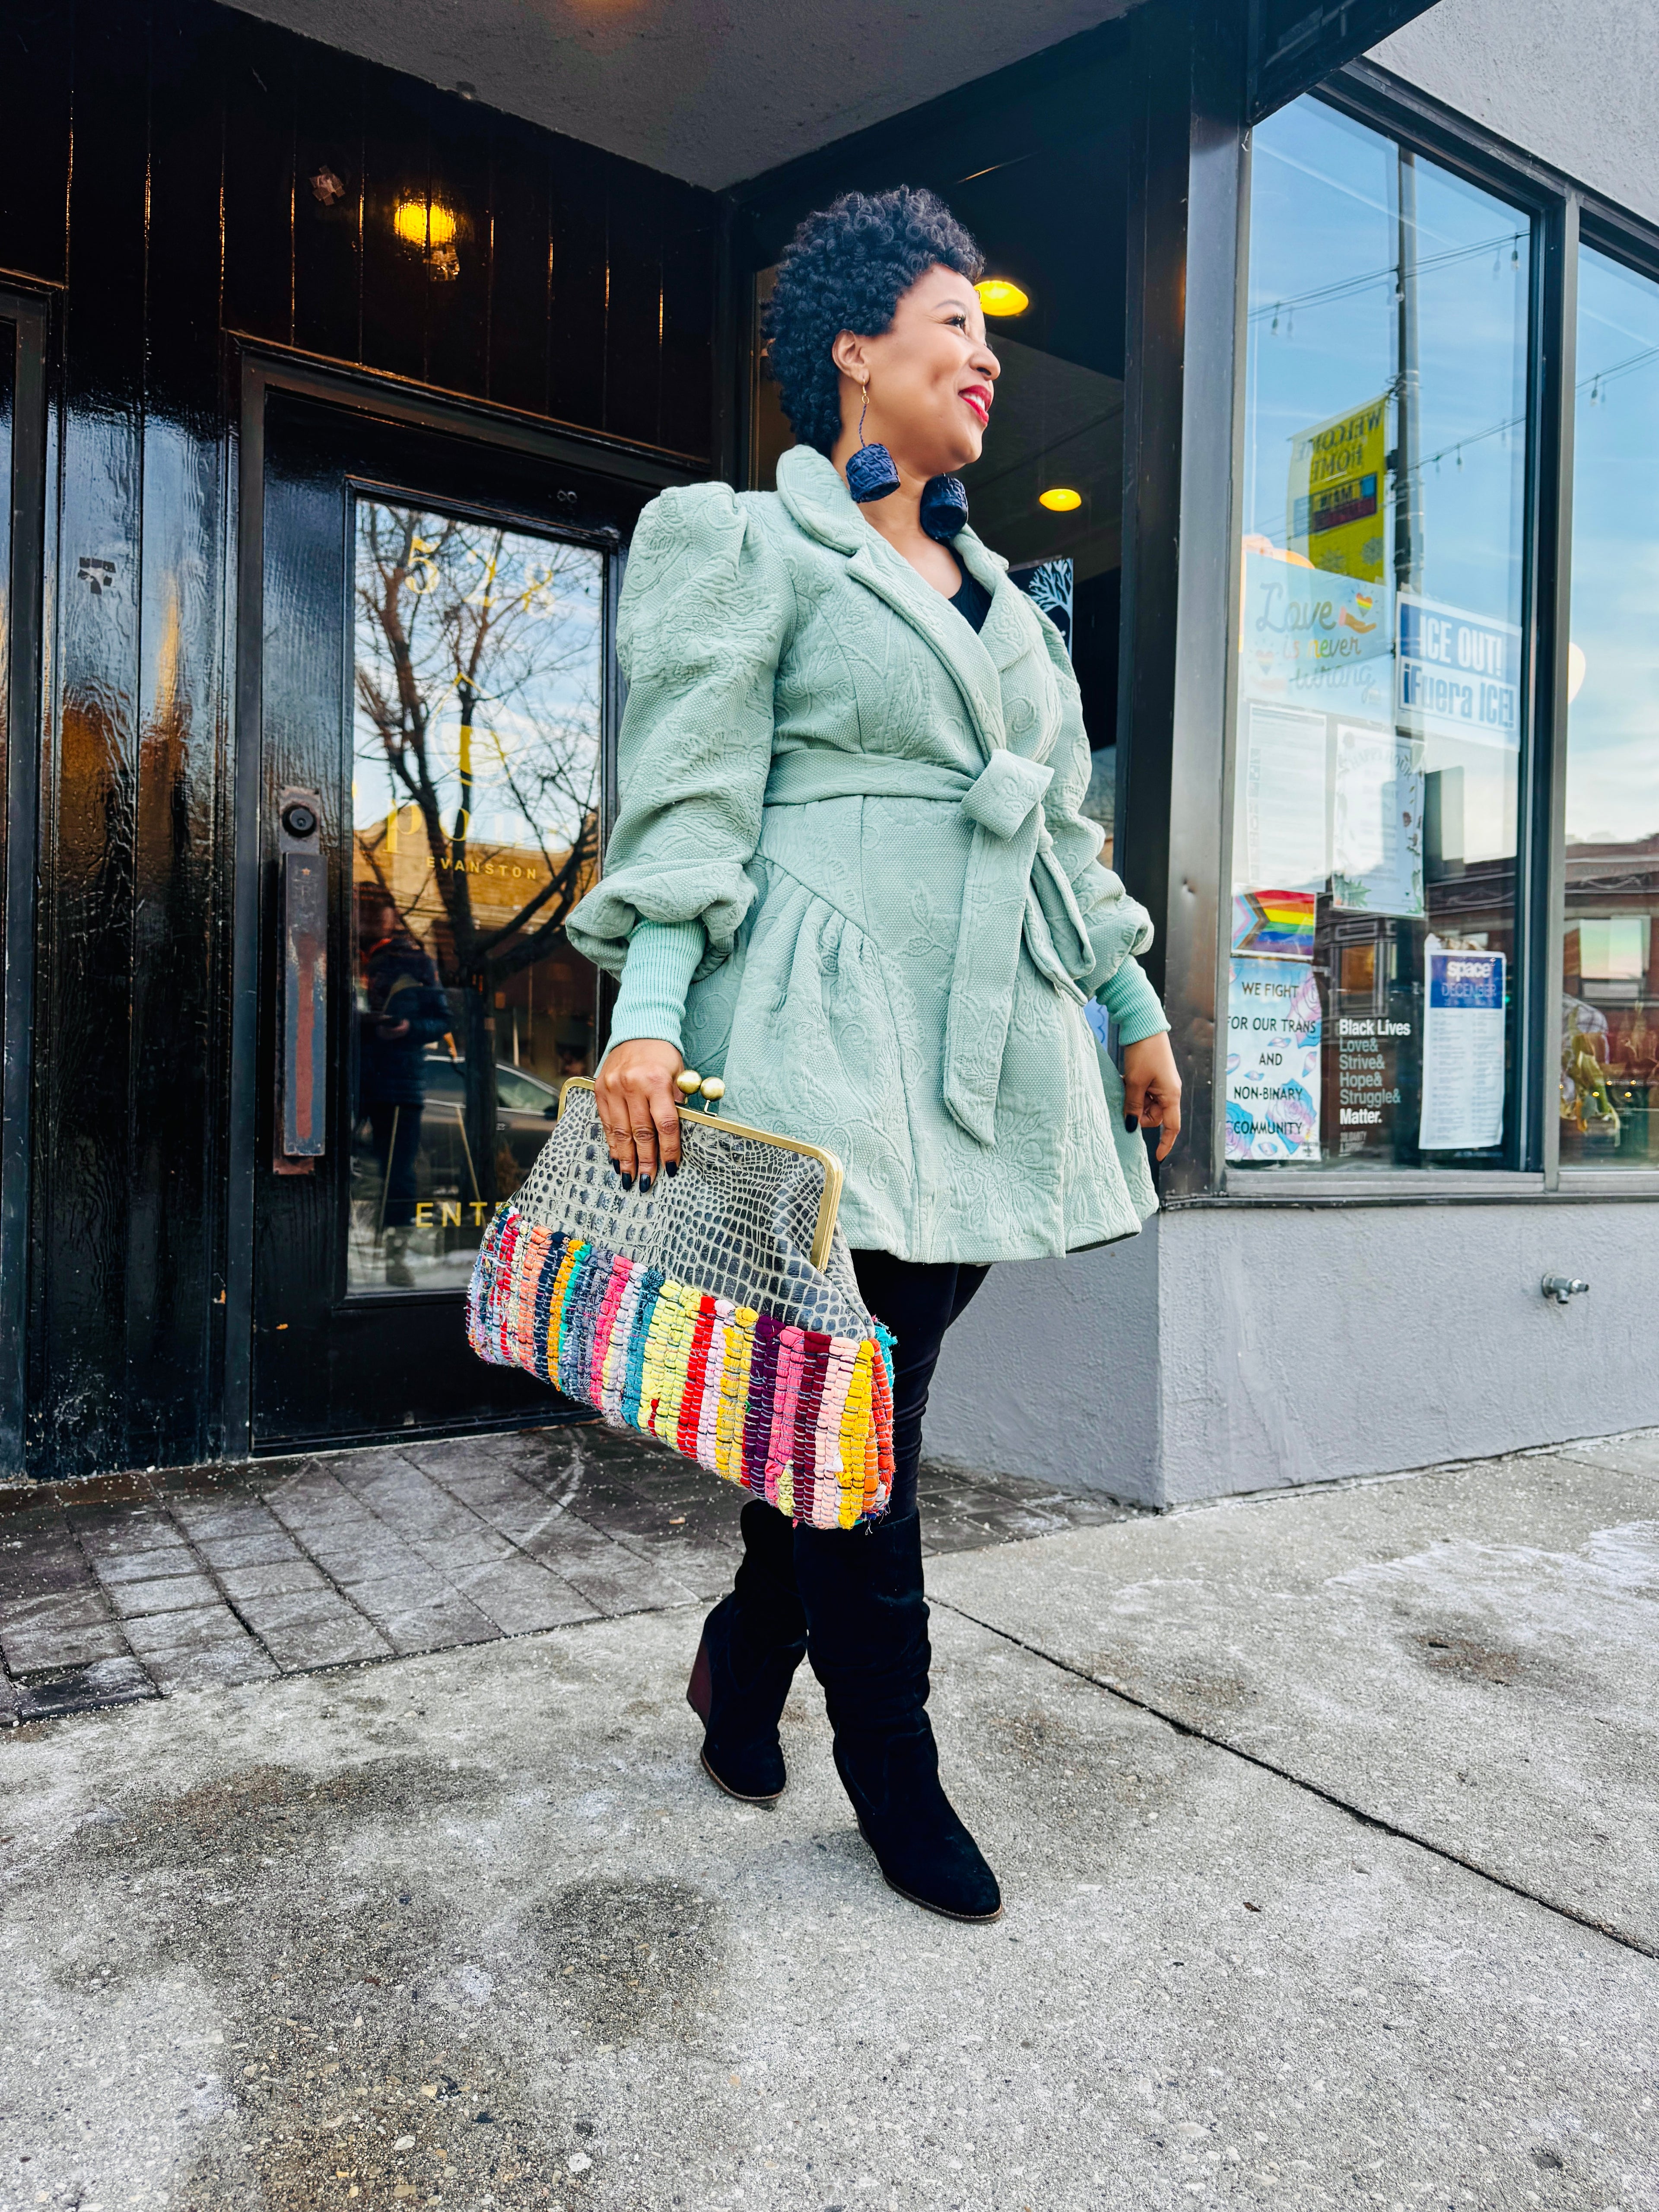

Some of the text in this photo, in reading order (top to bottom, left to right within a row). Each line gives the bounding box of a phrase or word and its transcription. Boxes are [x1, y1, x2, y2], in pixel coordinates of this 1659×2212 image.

[405, 536, 556, 619] 528
[1256, 582, 1336, 633] Love
[1284, 635, 1362, 659] is never
[1420, 615, 1502, 677] ICE OUT!
[1479, 683, 1514, 728] ICE!
[426, 856, 536, 880] EVANSTON
[1447, 961, 1491, 982] space
[1242, 981, 1300, 998] WE FIGHT
[1253, 1017, 1277, 1031] OUR
[1281, 1019, 1316, 1033] TRANS
[1339, 1018, 1411, 1036] Black Lives
[1340, 1037, 1378, 1052] Love&
[1259, 1052, 1283, 1065] AND
[1339, 1053, 1385, 1070] Strive&
[1340, 1071, 1382, 1091] Hope&
[1234, 1086, 1303, 1101] NON-BINARY
[1340, 1088, 1401, 1108] Struggle&
[1340, 1108, 1382, 1125] Matter.
[1233, 1121, 1302, 1135] COMMUNITY
[416, 1201, 504, 1228] ENT
